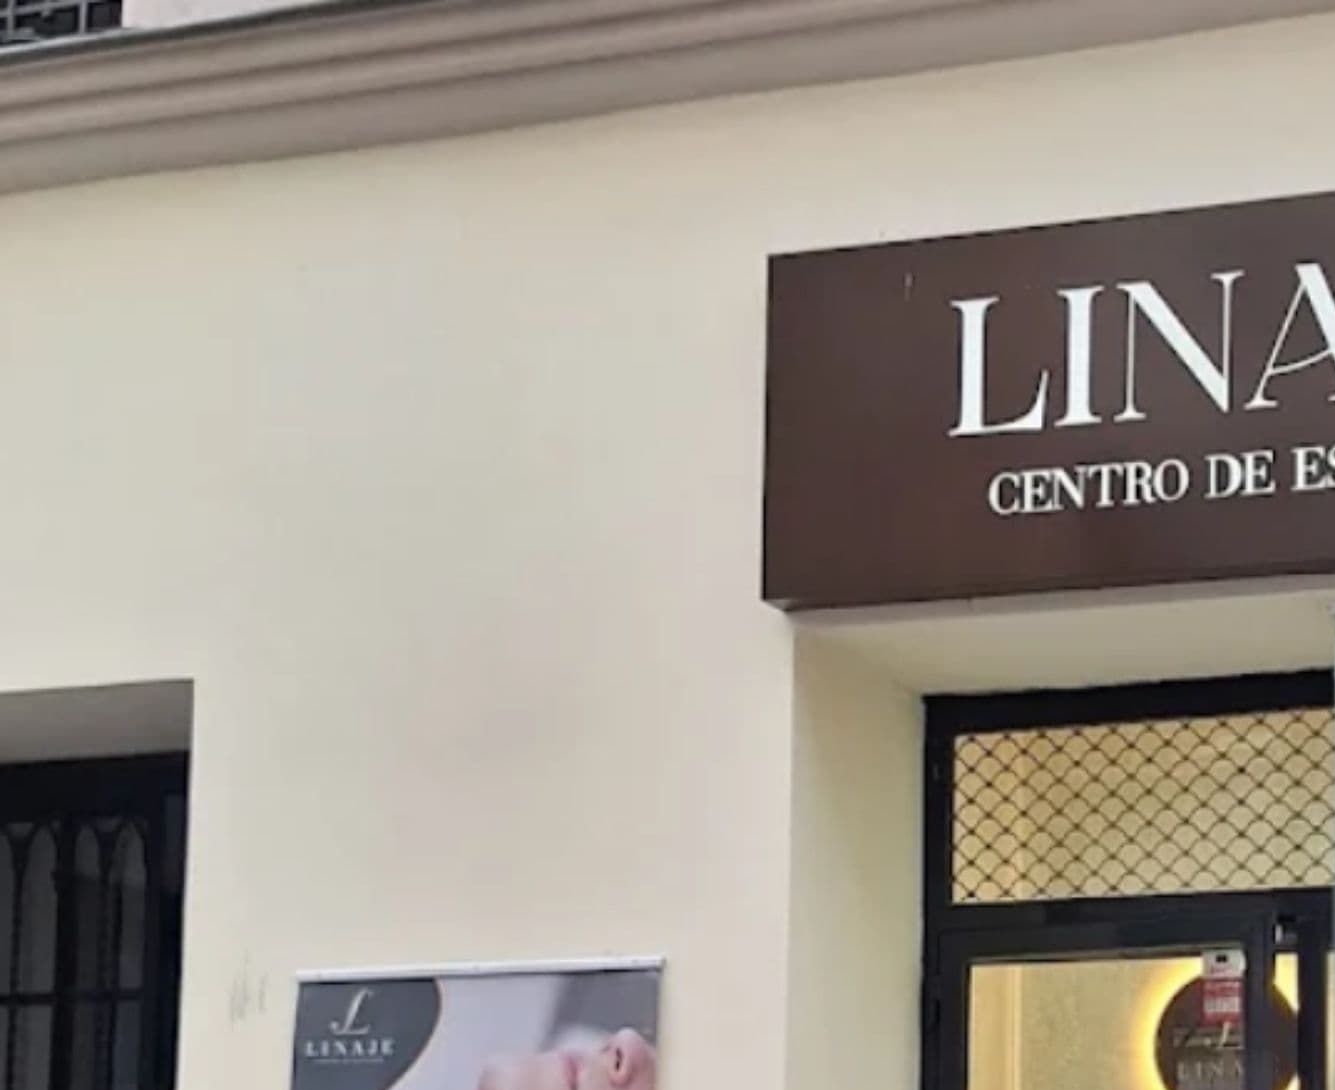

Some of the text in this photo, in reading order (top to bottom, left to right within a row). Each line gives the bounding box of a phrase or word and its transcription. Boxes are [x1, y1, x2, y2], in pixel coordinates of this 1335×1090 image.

[988, 459, 1190, 515] CENTRO
[1205, 450, 1275, 500] DE
[305, 1039, 394, 1057] LINAJE
